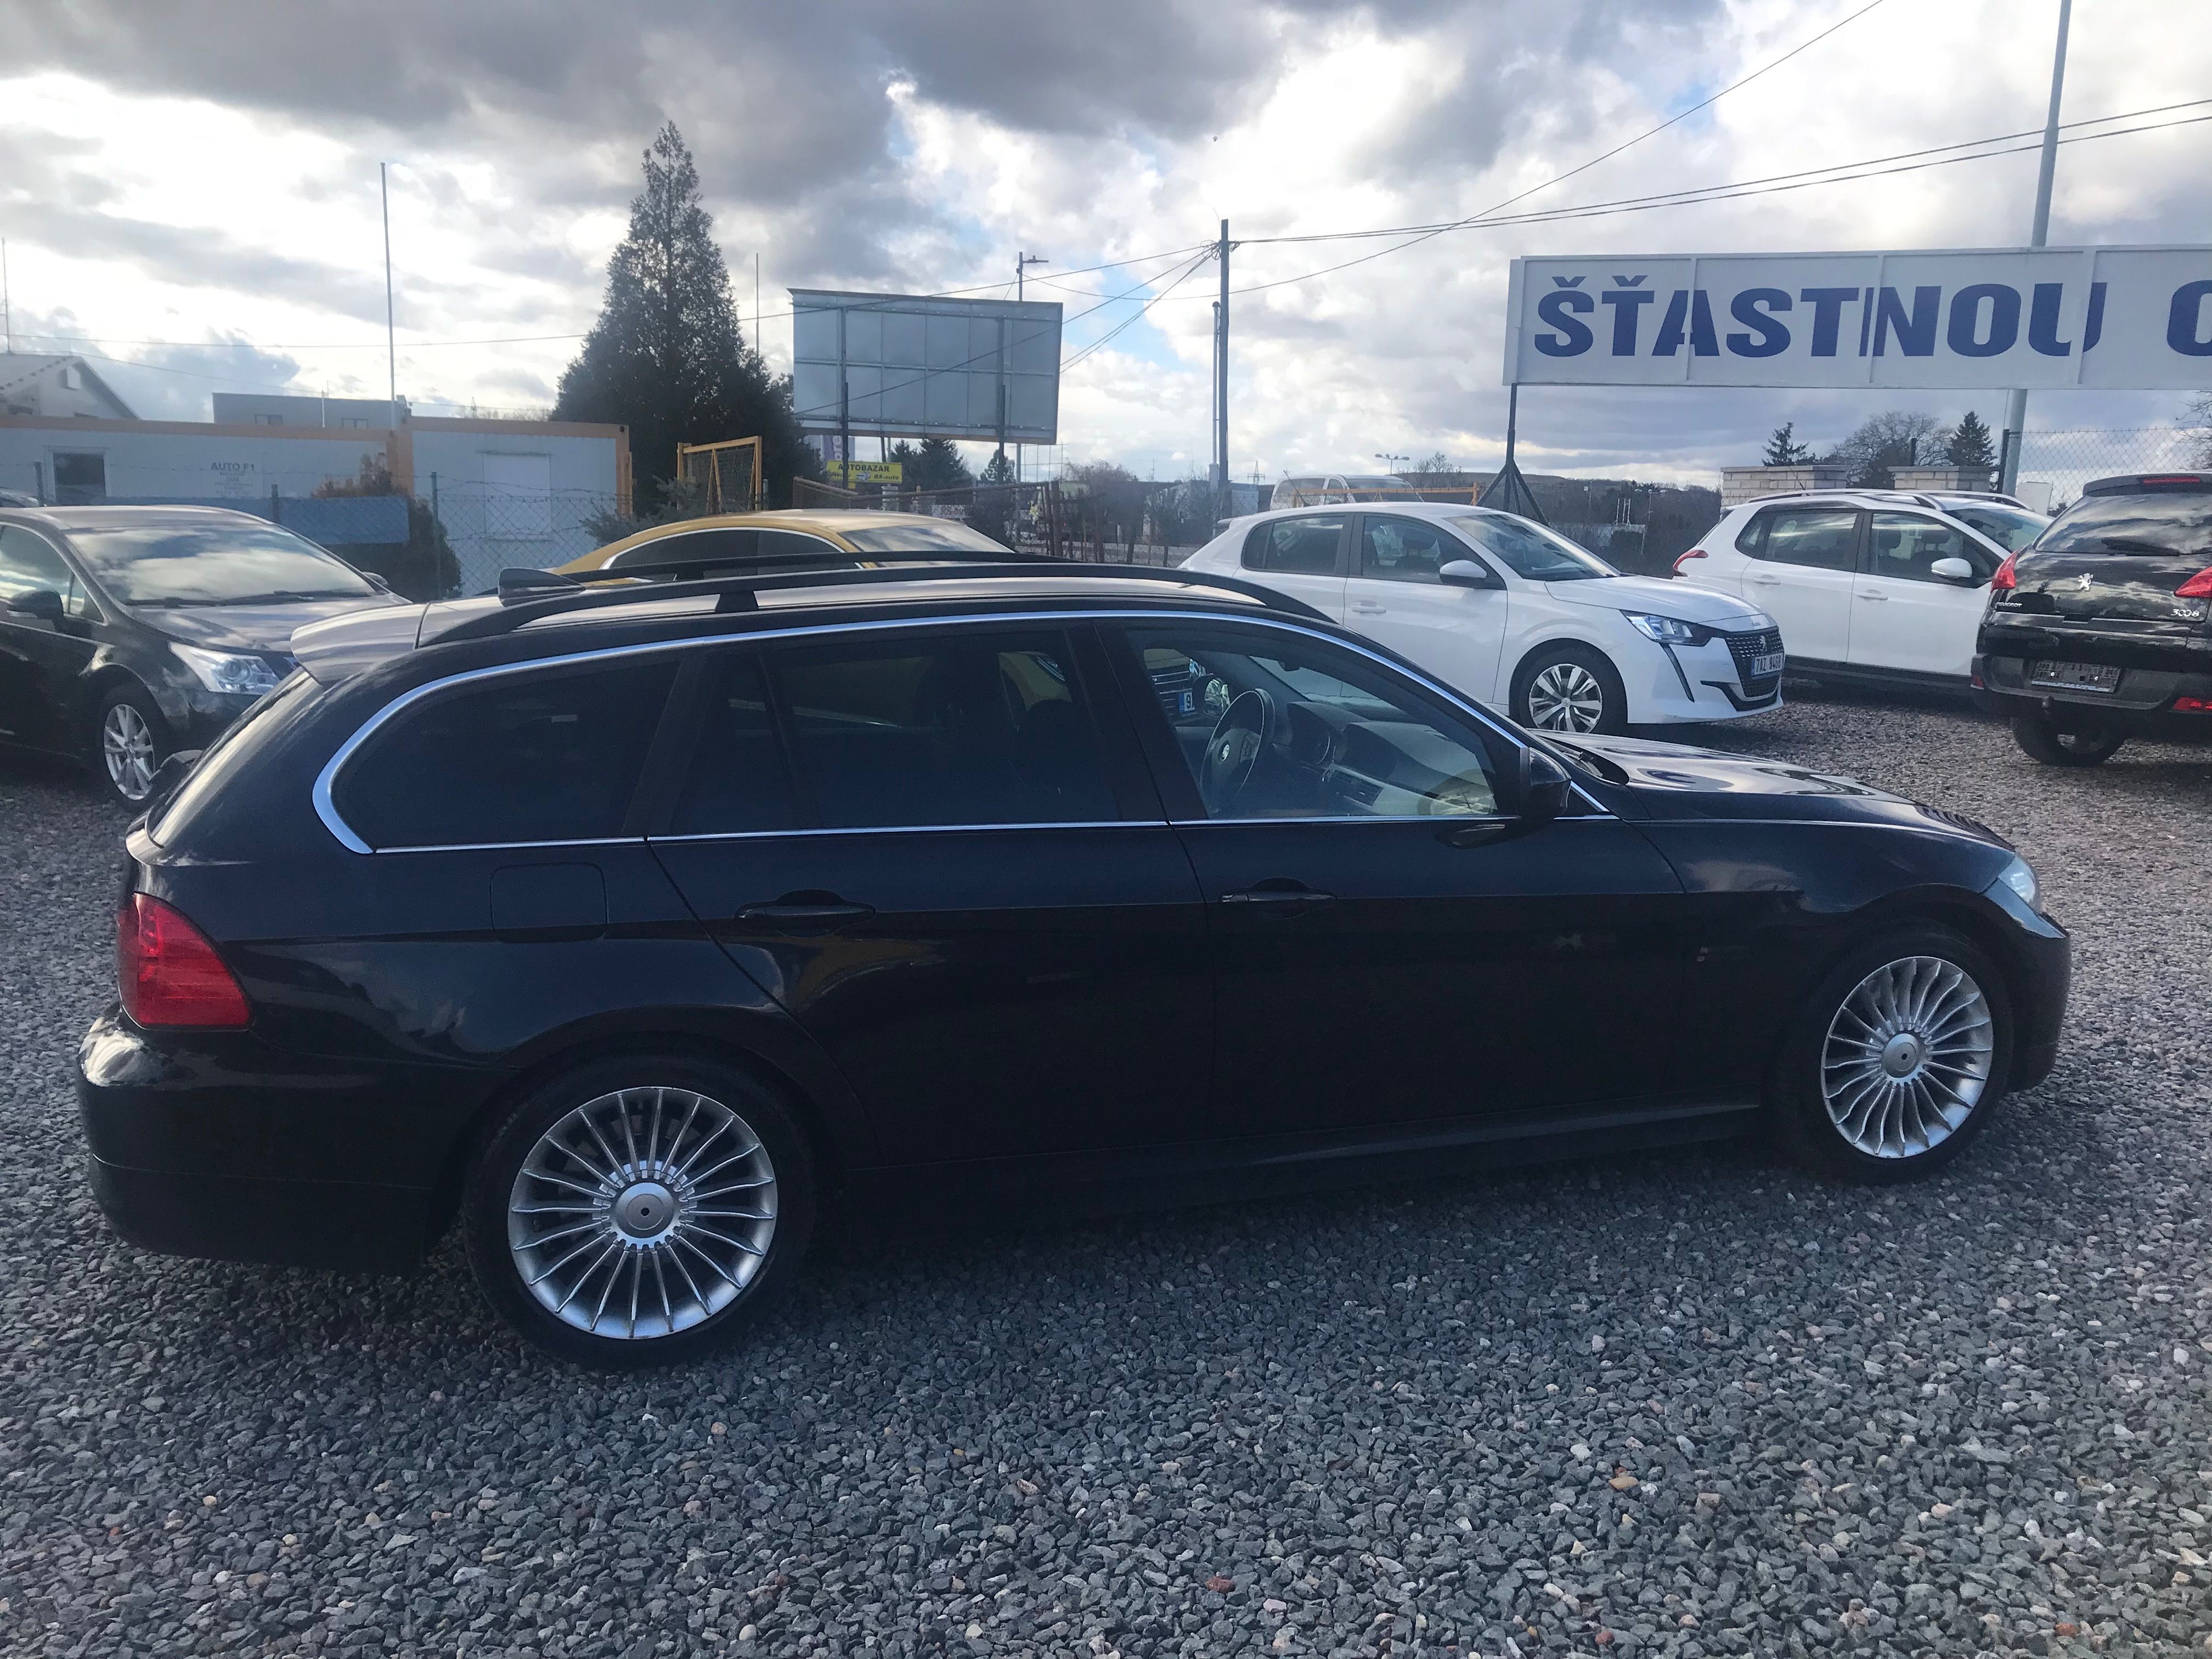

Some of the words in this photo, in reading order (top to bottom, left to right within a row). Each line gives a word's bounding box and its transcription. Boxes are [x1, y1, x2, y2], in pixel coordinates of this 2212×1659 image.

[1533, 274, 2108, 358] ŠŤASTNOU
[211, 462, 240, 471] AUTO
[838, 464, 890, 472] ATOBAZAR
[2170, 608, 2200, 617] 3008
